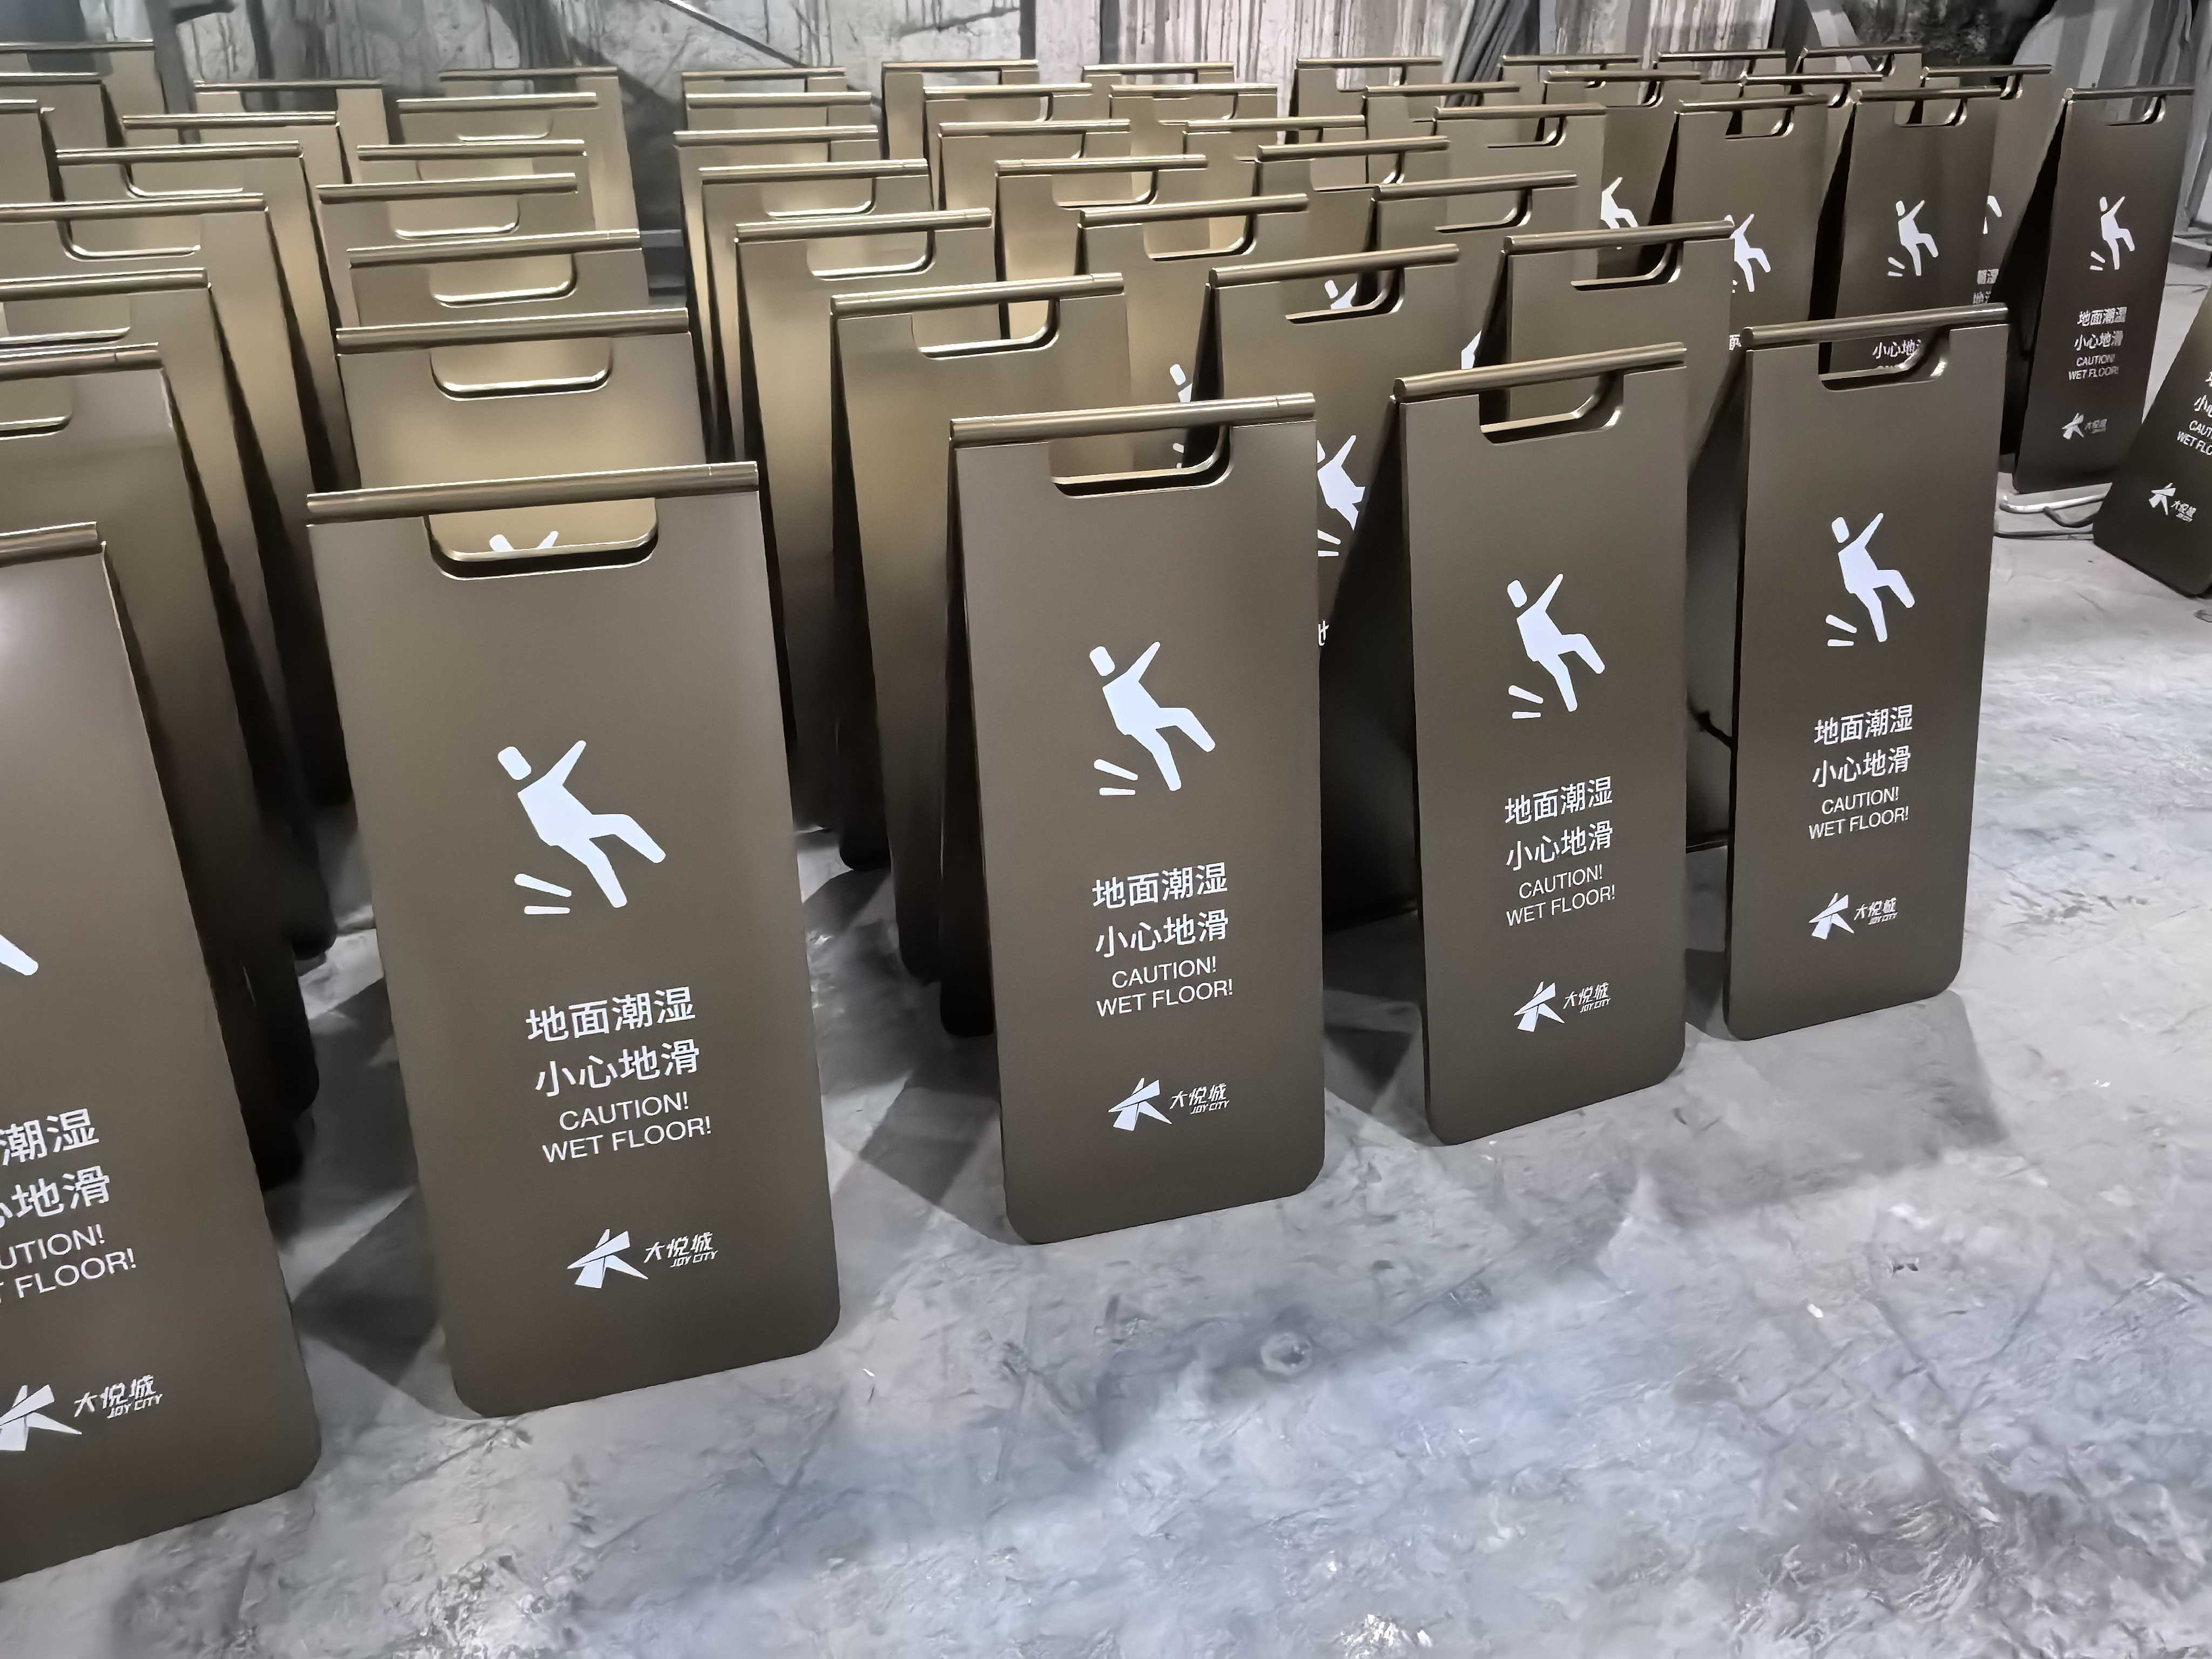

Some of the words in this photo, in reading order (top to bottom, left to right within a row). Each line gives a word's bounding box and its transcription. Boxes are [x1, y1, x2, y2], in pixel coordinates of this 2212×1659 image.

[1872, 339, 1921, 359] 小心地
[2069, 369, 2087, 380] WET
[2177, 431, 2197, 446] WET
[1815, 705, 1912, 745] 地面潮湿
[1813, 745, 1911, 787] 小心地滑
[1505, 777, 1613, 824] 地面潮湿
[1822, 786, 1898, 814] CAUTION!
[1809, 819, 1845, 839] WET
[1850, 806, 1908, 832] FLOOR!
[1507, 820, 1613, 871] 小心地滑
[1092, 862, 1228, 908] 地面潮湿
[1520, 864, 1602, 898] CAUTION!
[1506, 902, 1546, 926] WET
[1552, 885, 1615, 915] FLOOR!
[1096, 909, 1228, 957] 小心地滑
[1112, 956, 1216, 988] CAUTION!
[526, 987, 695, 1041] 地面潮湿
[1096, 993, 1146, 1016] WET
[1153, 979, 1232, 1008] FLOOR!
[1563, 982, 1609, 1009] 大悦城
[535, 1039, 699, 1097] 小心地滑
[559, 1091, 688, 1130] CAUTION!
[1170, 1083, 1226, 1109] 大悦城
[1190, 1104, 1208, 1114] JOY
[1209, 1100, 1229, 1111] CITY
[0, 1109, 99, 1165] 潮湿
[542, 1135, 603, 1162] WET
[612, 1116, 711, 1151] FLOOR!
[0, 1224, 104, 1269] UTION!
[644, 1232, 713, 1263] 大悦城
[670, 1256, 691, 1267] JOY
[693, 1251, 718, 1263] CITY
[15, 1249, 136, 1298] FLOOR!
[74, 1375, 156, 1417] 大悦城
[107, 1404, 131, 1418] JOY
[134, 1394, 163, 1410] CITY
